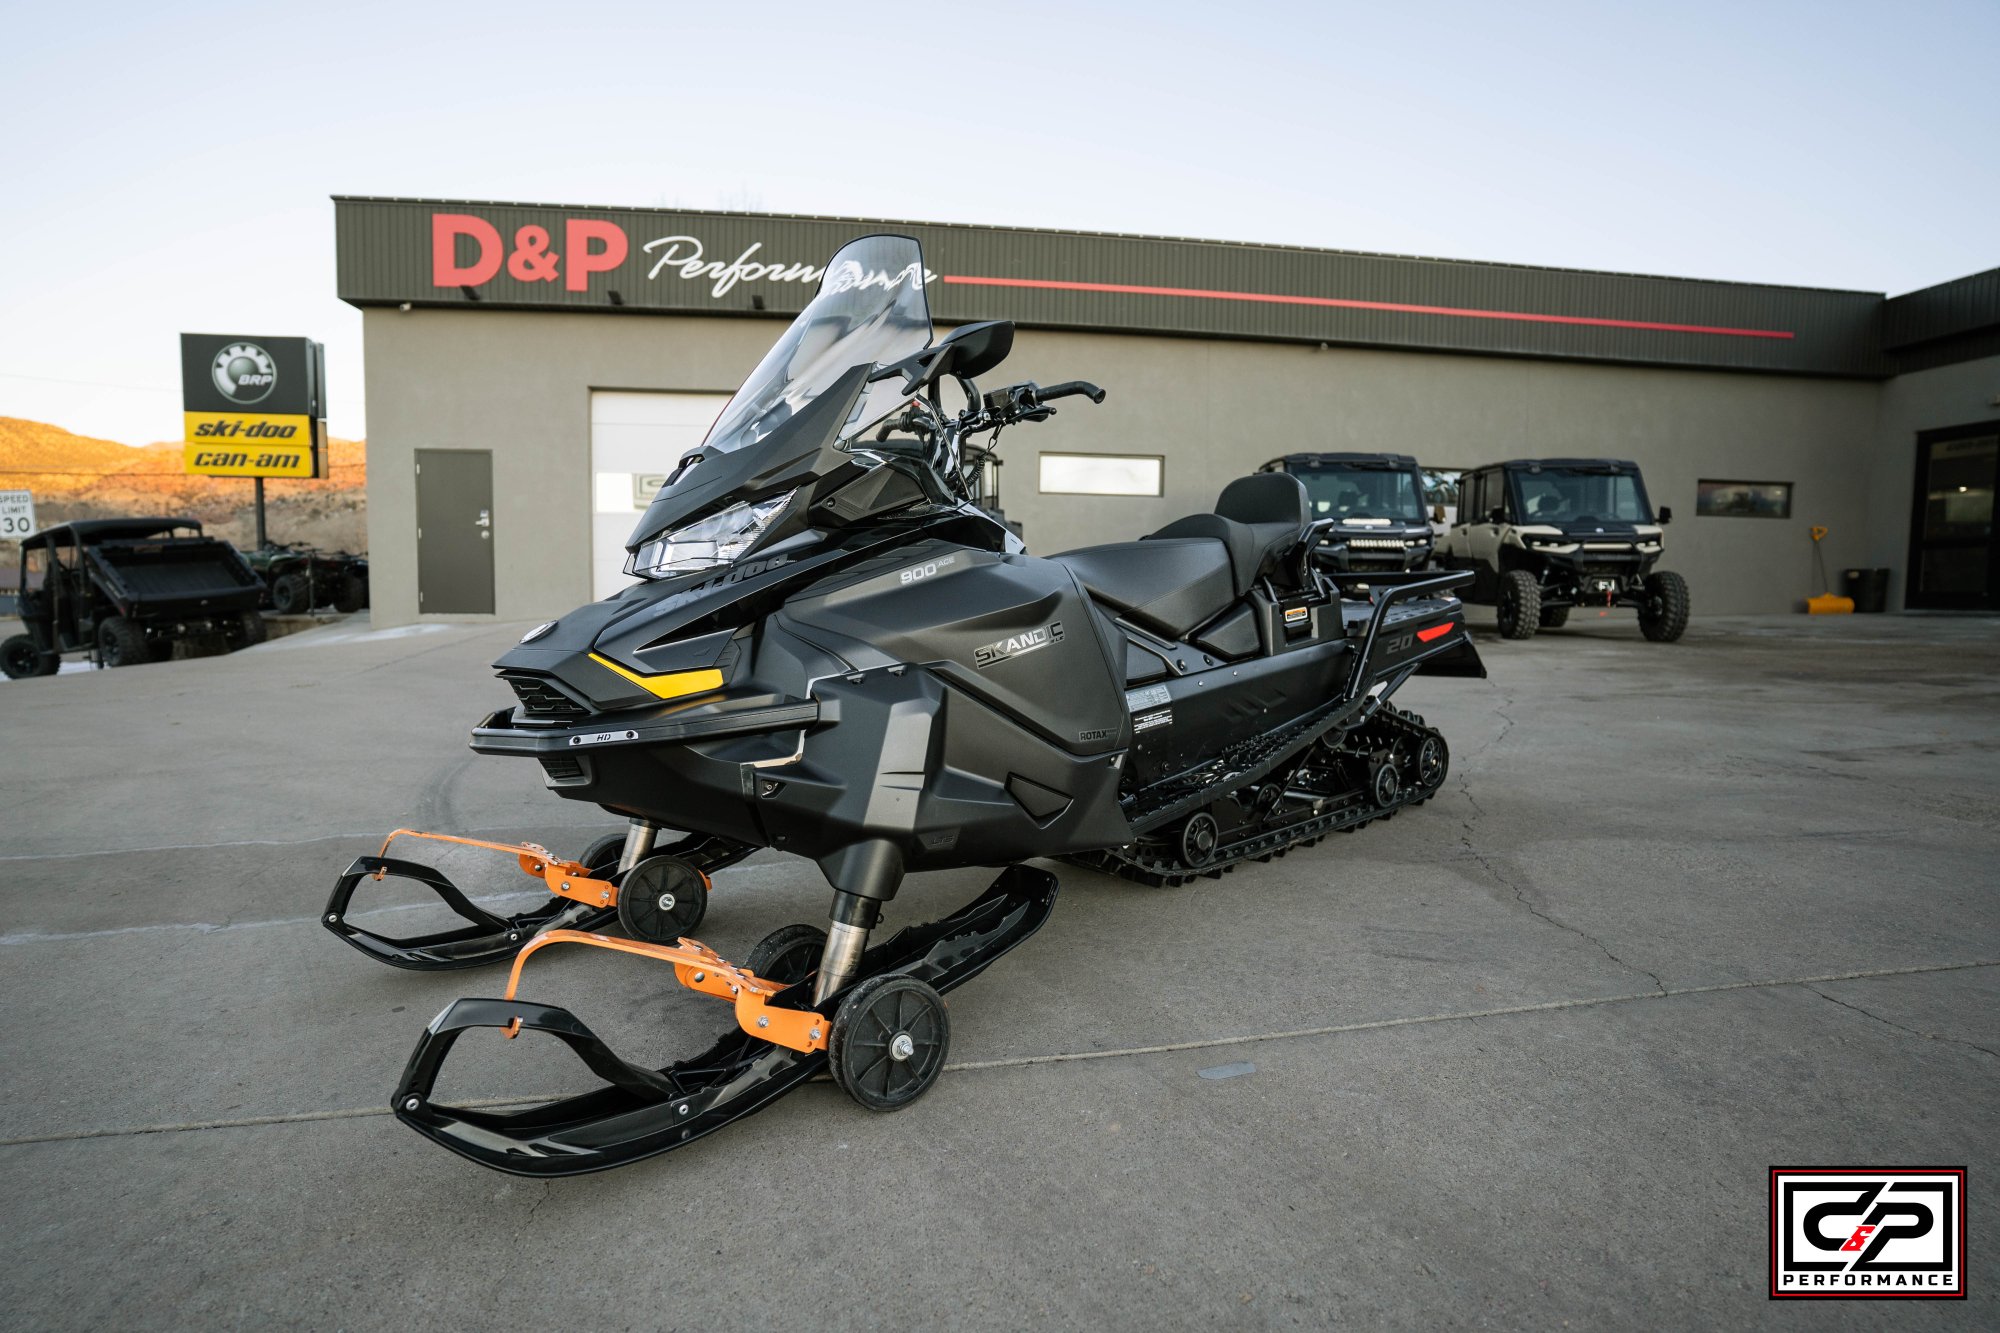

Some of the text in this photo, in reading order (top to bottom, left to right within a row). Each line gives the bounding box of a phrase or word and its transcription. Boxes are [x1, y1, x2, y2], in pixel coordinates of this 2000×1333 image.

[432, 213, 629, 292] D&P
[238, 374, 273, 386] BRP
[194, 420, 298, 438] ski-doo
[194, 452, 300, 468] can-am
[2, 505, 26, 514] LIMIT
[3, 517, 30, 532] 30
[901, 556, 955, 585] 900 ACE
[974, 621, 1064, 664] SKANDIC
[1080, 730, 1108, 741] ROTAX
